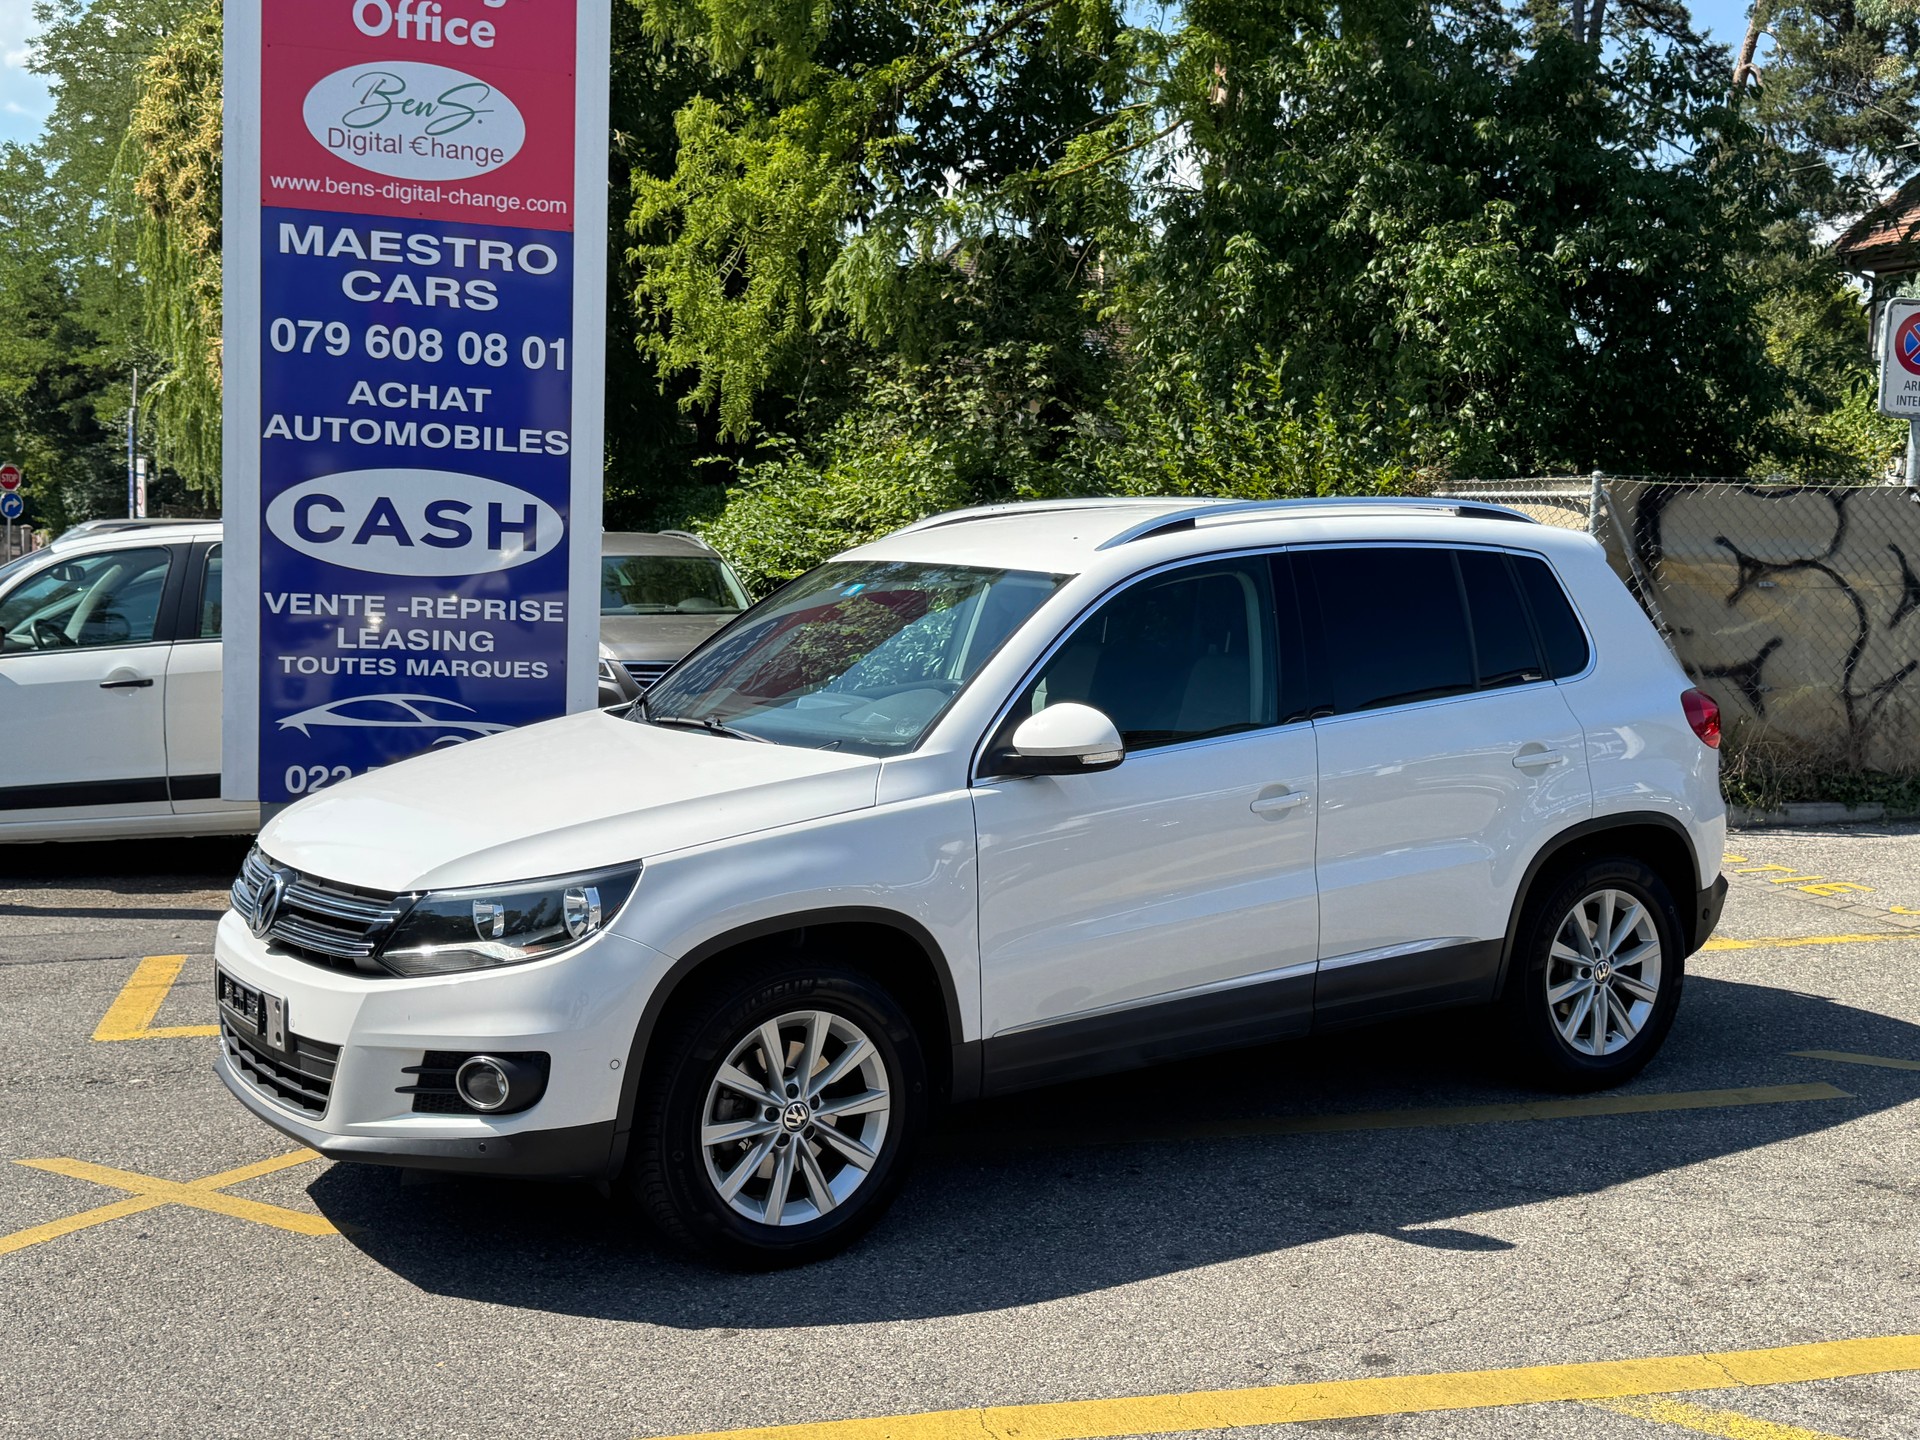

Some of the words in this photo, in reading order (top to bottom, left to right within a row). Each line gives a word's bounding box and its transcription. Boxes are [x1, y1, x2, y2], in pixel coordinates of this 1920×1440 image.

[352, 0, 496, 48] Office
[327, 127, 402, 156] Digital
[270, 175, 567, 214] www.bens-digital-change.com
[279, 222, 558, 275] MAESTRO
[341, 270, 499, 312] CARS
[269, 317, 350, 356] 079
[365, 324, 443, 363] 608
[457, 331, 508, 367] 08
[521, 336, 566, 371] 01
[347, 380, 492, 413] ACHAT
[262, 414, 570, 455] AUTOMOBILES
[1, 473, 18, 483] STOP
[293, 493, 538, 552] CASH
[264, 592, 386, 617] VENTE
[337, 627, 494, 652] LEASING
[278, 656, 397, 675] TOUTES
[406, 659, 549, 678] MARQUES
